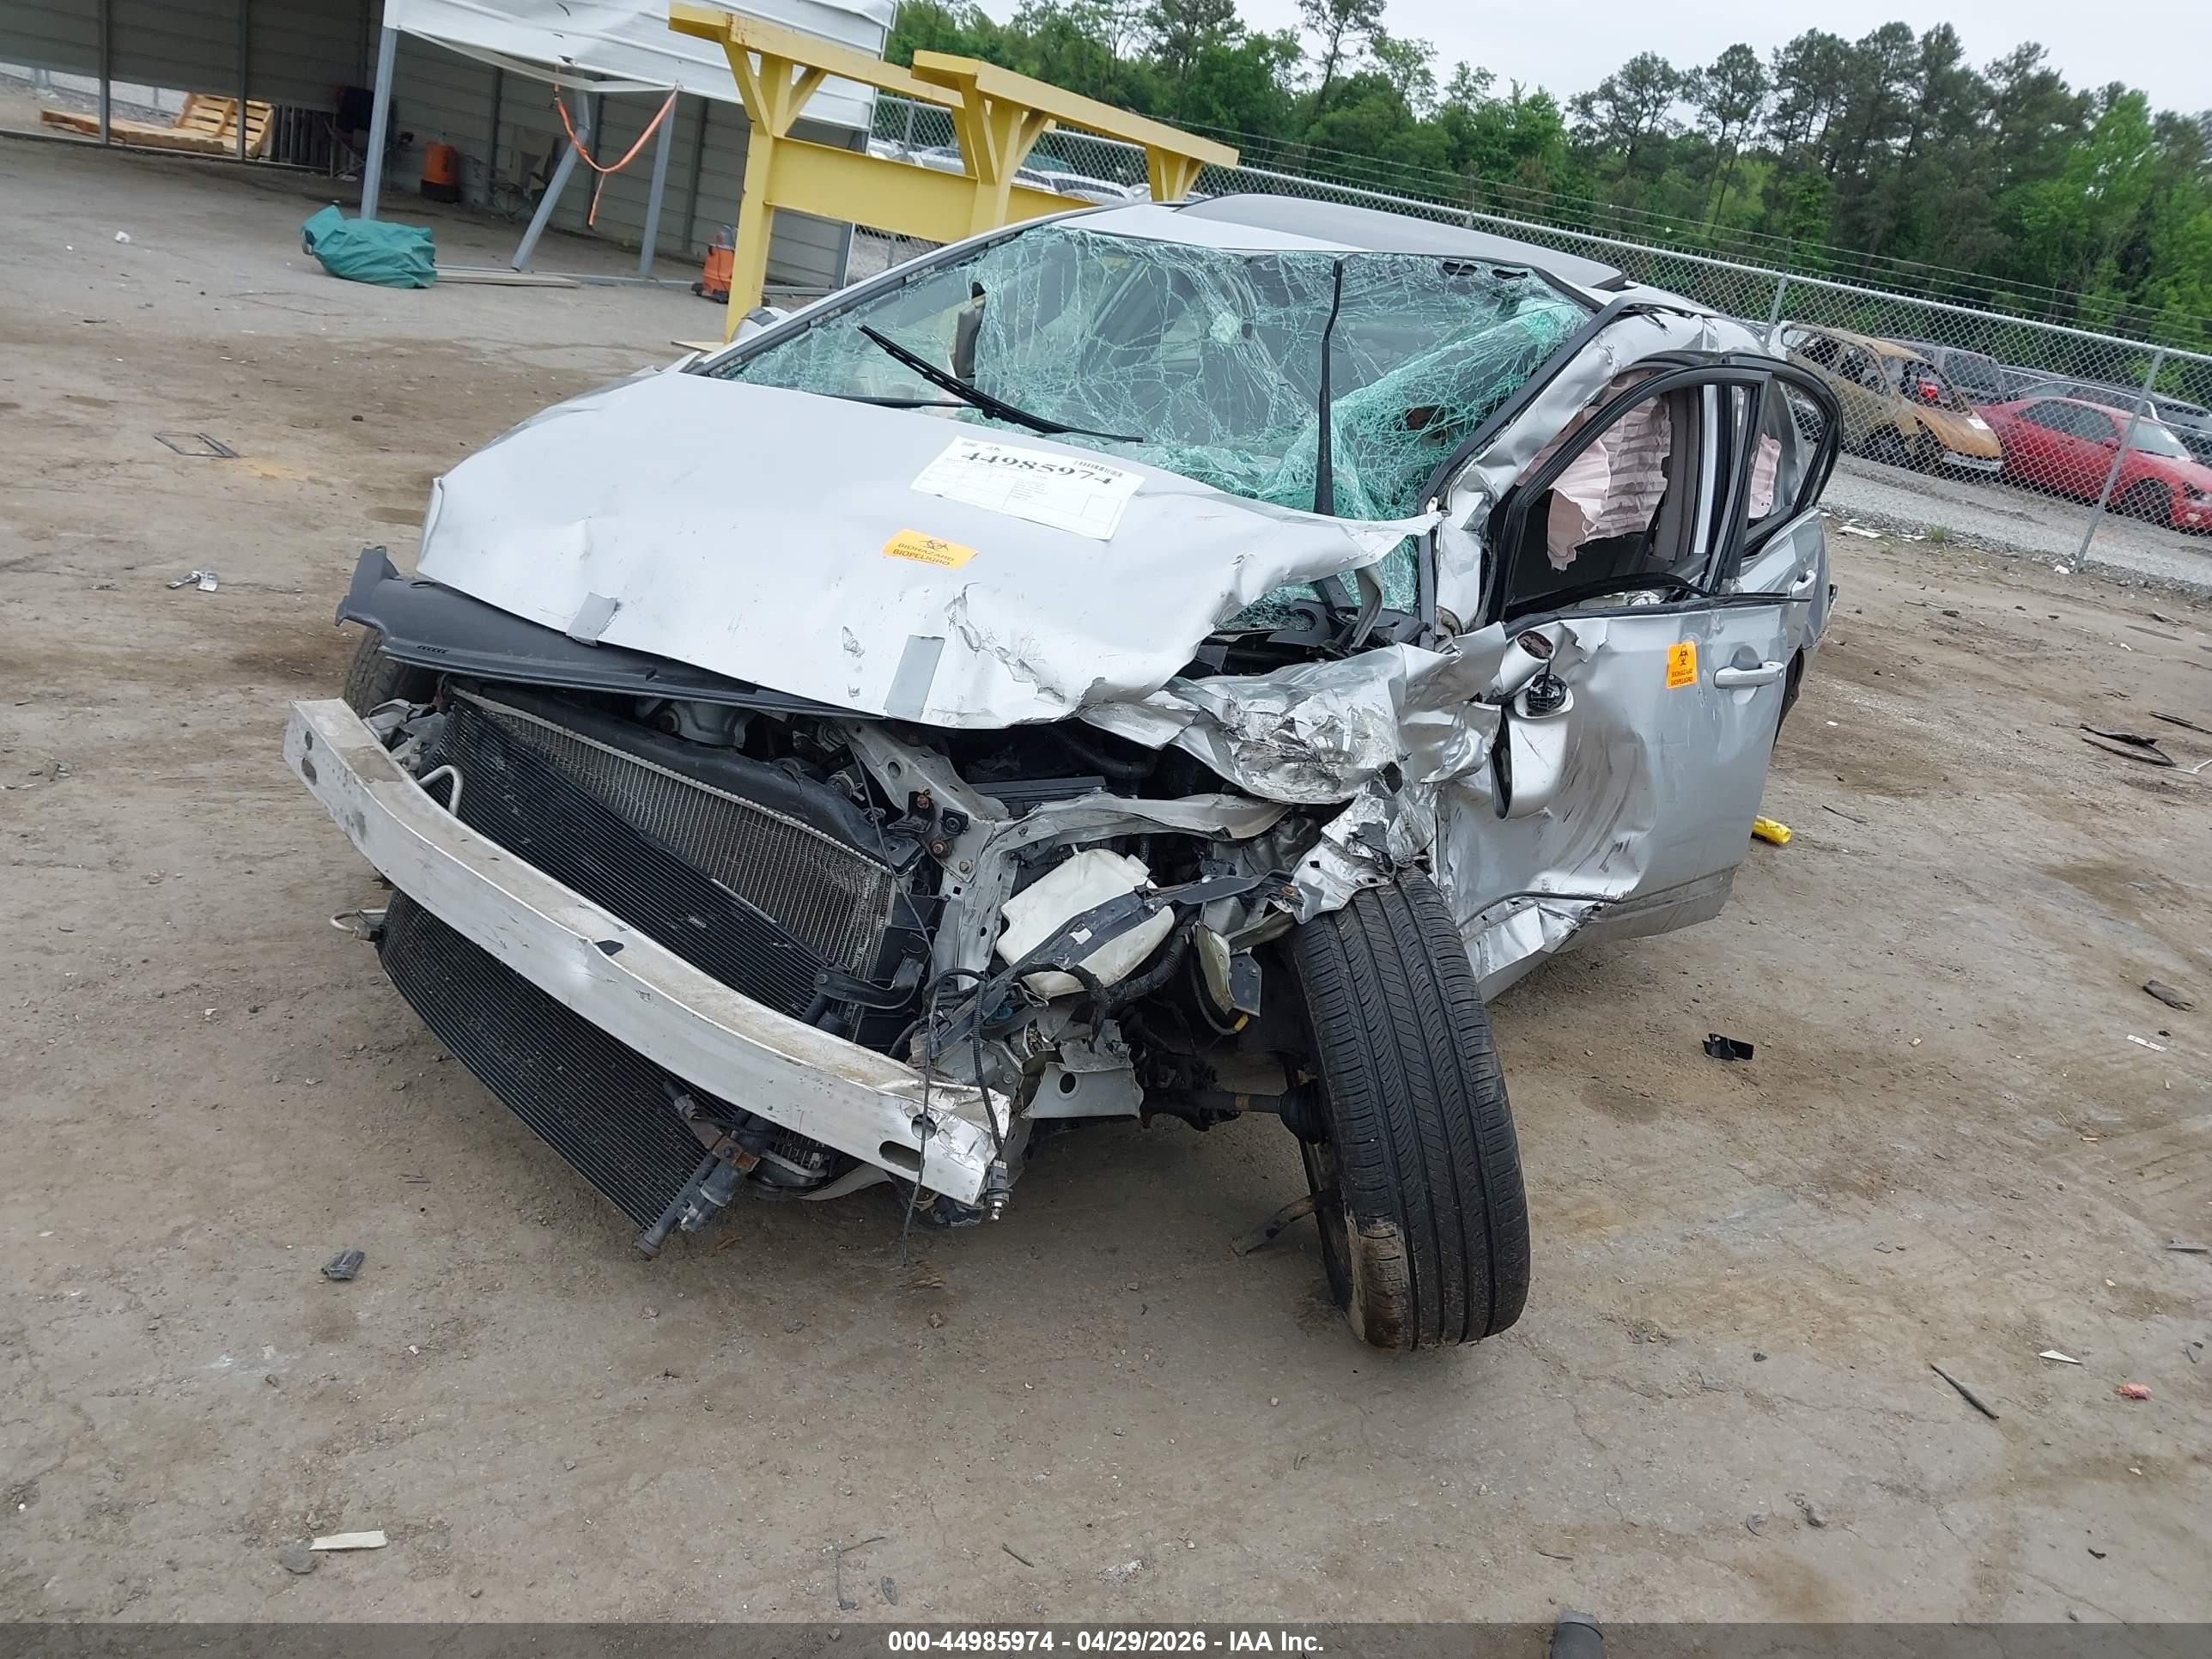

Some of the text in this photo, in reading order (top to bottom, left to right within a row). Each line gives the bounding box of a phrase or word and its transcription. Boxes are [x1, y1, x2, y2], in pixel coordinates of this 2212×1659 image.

[961, 452, 1113, 485] 44985974
[892, 549, 951, 566] BIOPELIGRO
[897, 543, 955, 562] BIOHAZARD
